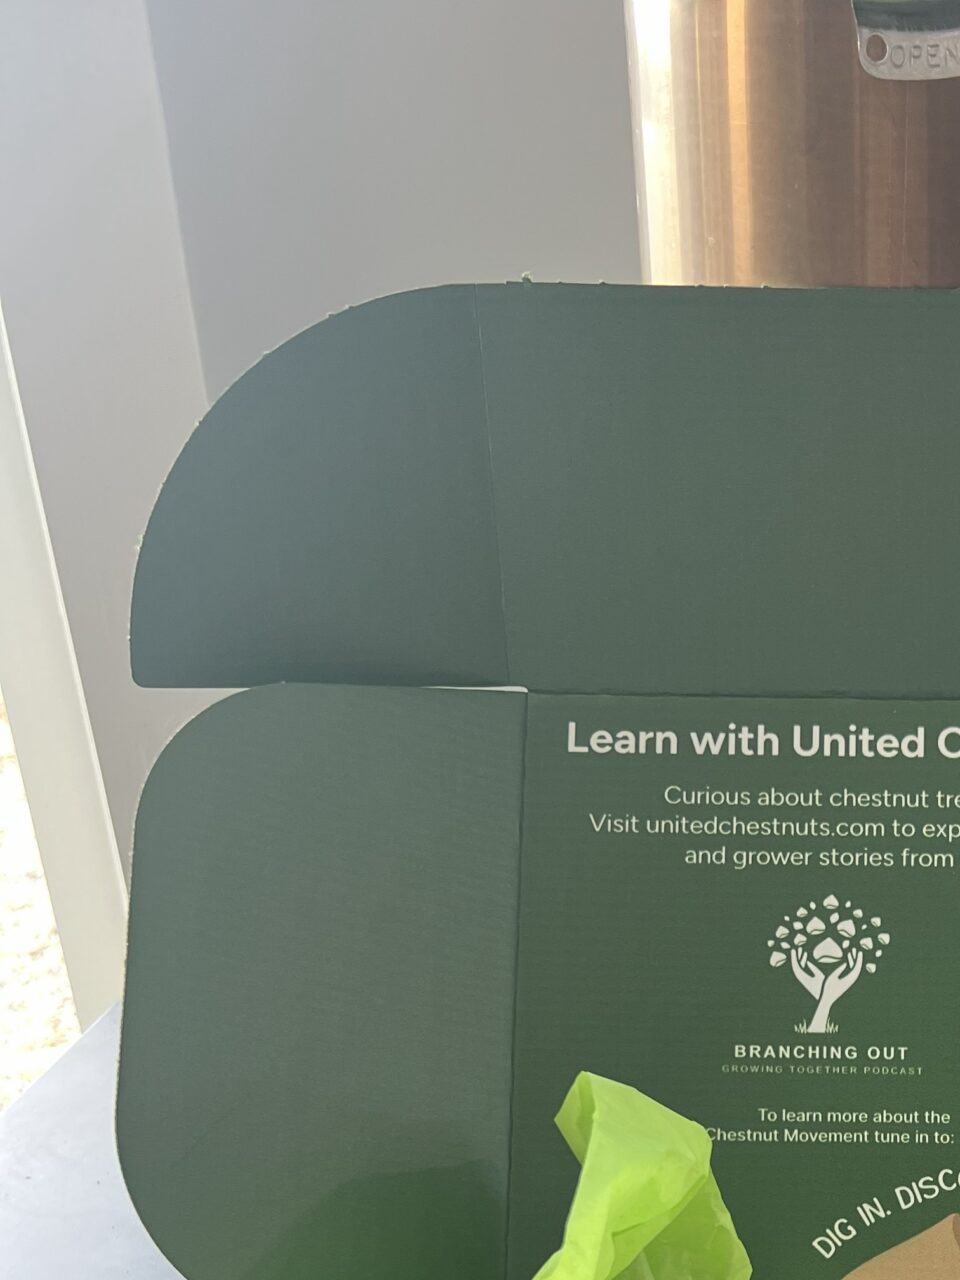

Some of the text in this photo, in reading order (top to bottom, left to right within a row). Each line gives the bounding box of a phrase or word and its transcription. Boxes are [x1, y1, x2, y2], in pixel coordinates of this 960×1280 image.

[568, 722, 677, 754] Learn
[690, 723, 779, 755] with
[793, 724, 924, 758] United
[665, 786, 750, 805] Curious
[758, 787, 822, 806] about
[830, 788, 929, 808] chestnut
[589, 813, 639, 833] Visit
[647, 815, 884, 836] unitedchestnuts.com
[892, 819, 915, 837] to
[685, 846, 725, 864] and
[733, 851, 812, 869] grower
[820, 848, 894, 866] stories
[901, 848, 953, 867] from
[735, 1045, 908, 1060] BRANCHING OUT
[722, 1065, 922, 1075] GROWING TOGETHER PODCAST
[758, 1108, 950, 1124] To learn more about the
[784, 1129, 869, 1143] Movement
[875, 1131, 910, 1143] tune
[916, 1130, 928, 1143] in
[934, 1131, 954, 1144] to:
[812, 1218, 857, 1259] DIG
[857, 1197, 892, 1227] IN.
